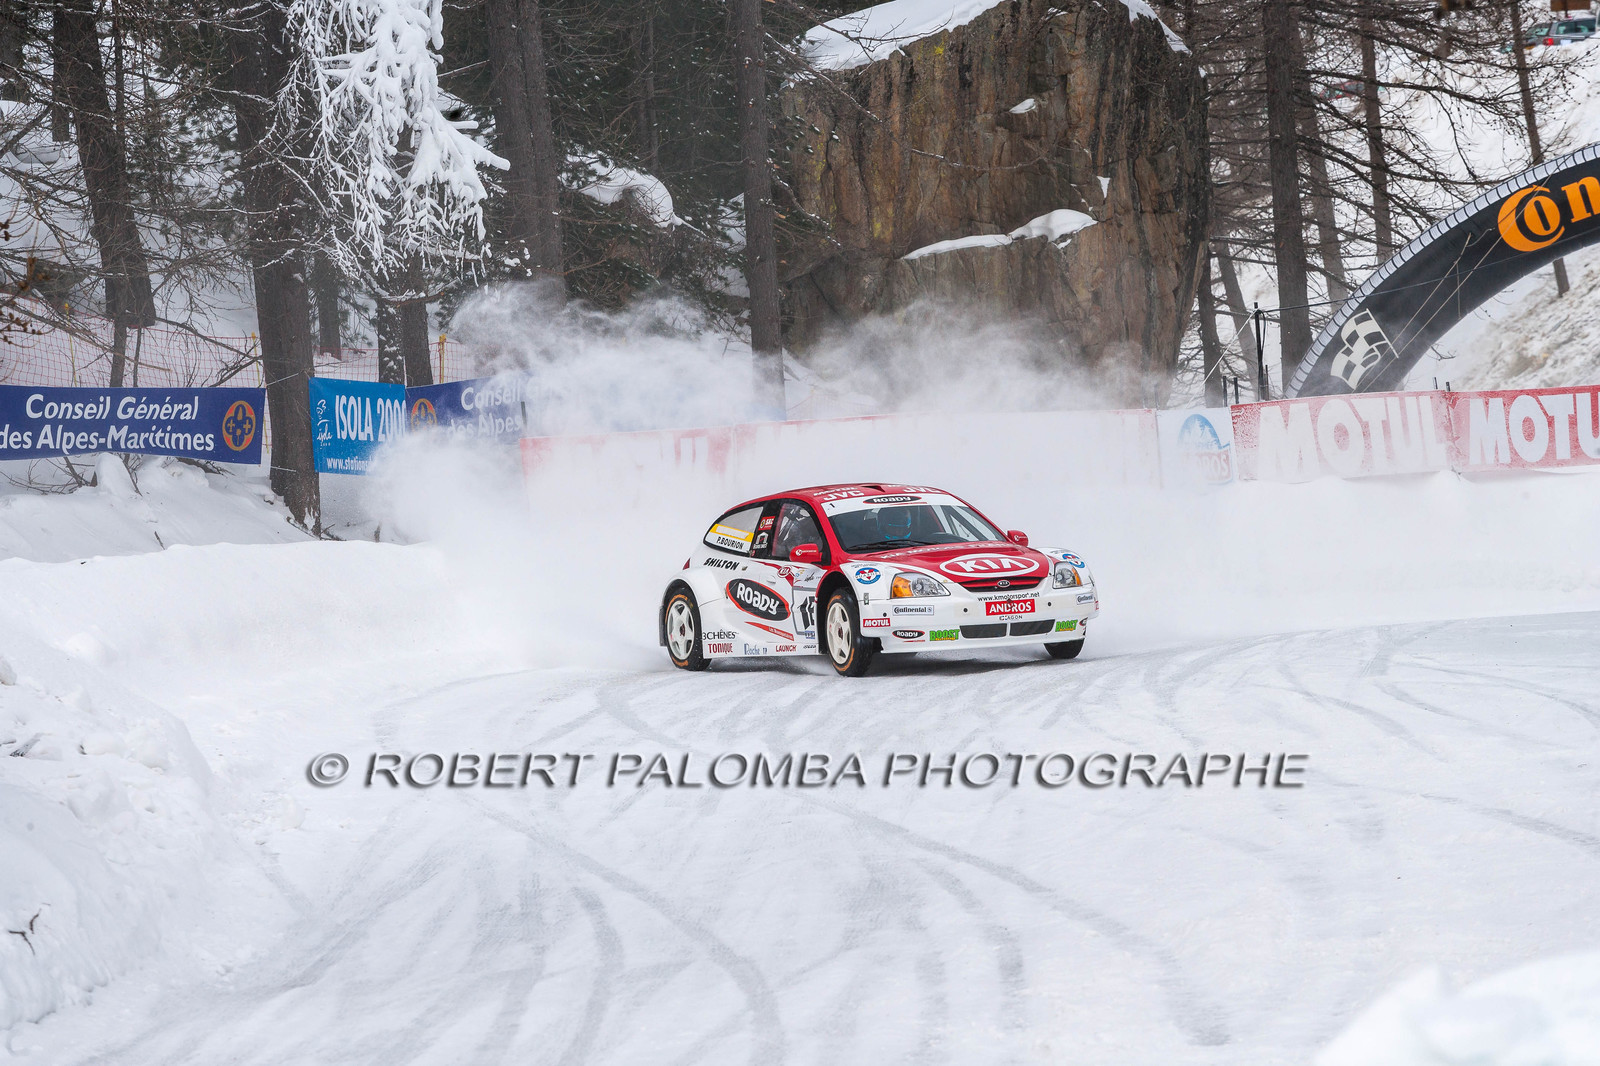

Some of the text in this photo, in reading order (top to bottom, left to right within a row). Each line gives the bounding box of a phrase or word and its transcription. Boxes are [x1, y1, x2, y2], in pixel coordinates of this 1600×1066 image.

[26, 393, 199, 421] Conseil Général
[335, 395, 374, 441] ISOLA
[36, 424, 215, 455] Alpes-Maritimes
[1258, 396, 1438, 481] MOTUL
[824, 490, 865, 501] JVC
[716, 536, 744, 550] P.BOURION
[703, 558, 740, 571] SHILTON
[953, 557, 1028, 573] KIA
[989, 602, 1032, 614] ANDROS
[864, 619, 890, 627] MOTUL
[1055, 620, 1078, 632] BOOST
[929, 629, 960, 641] BOOST
